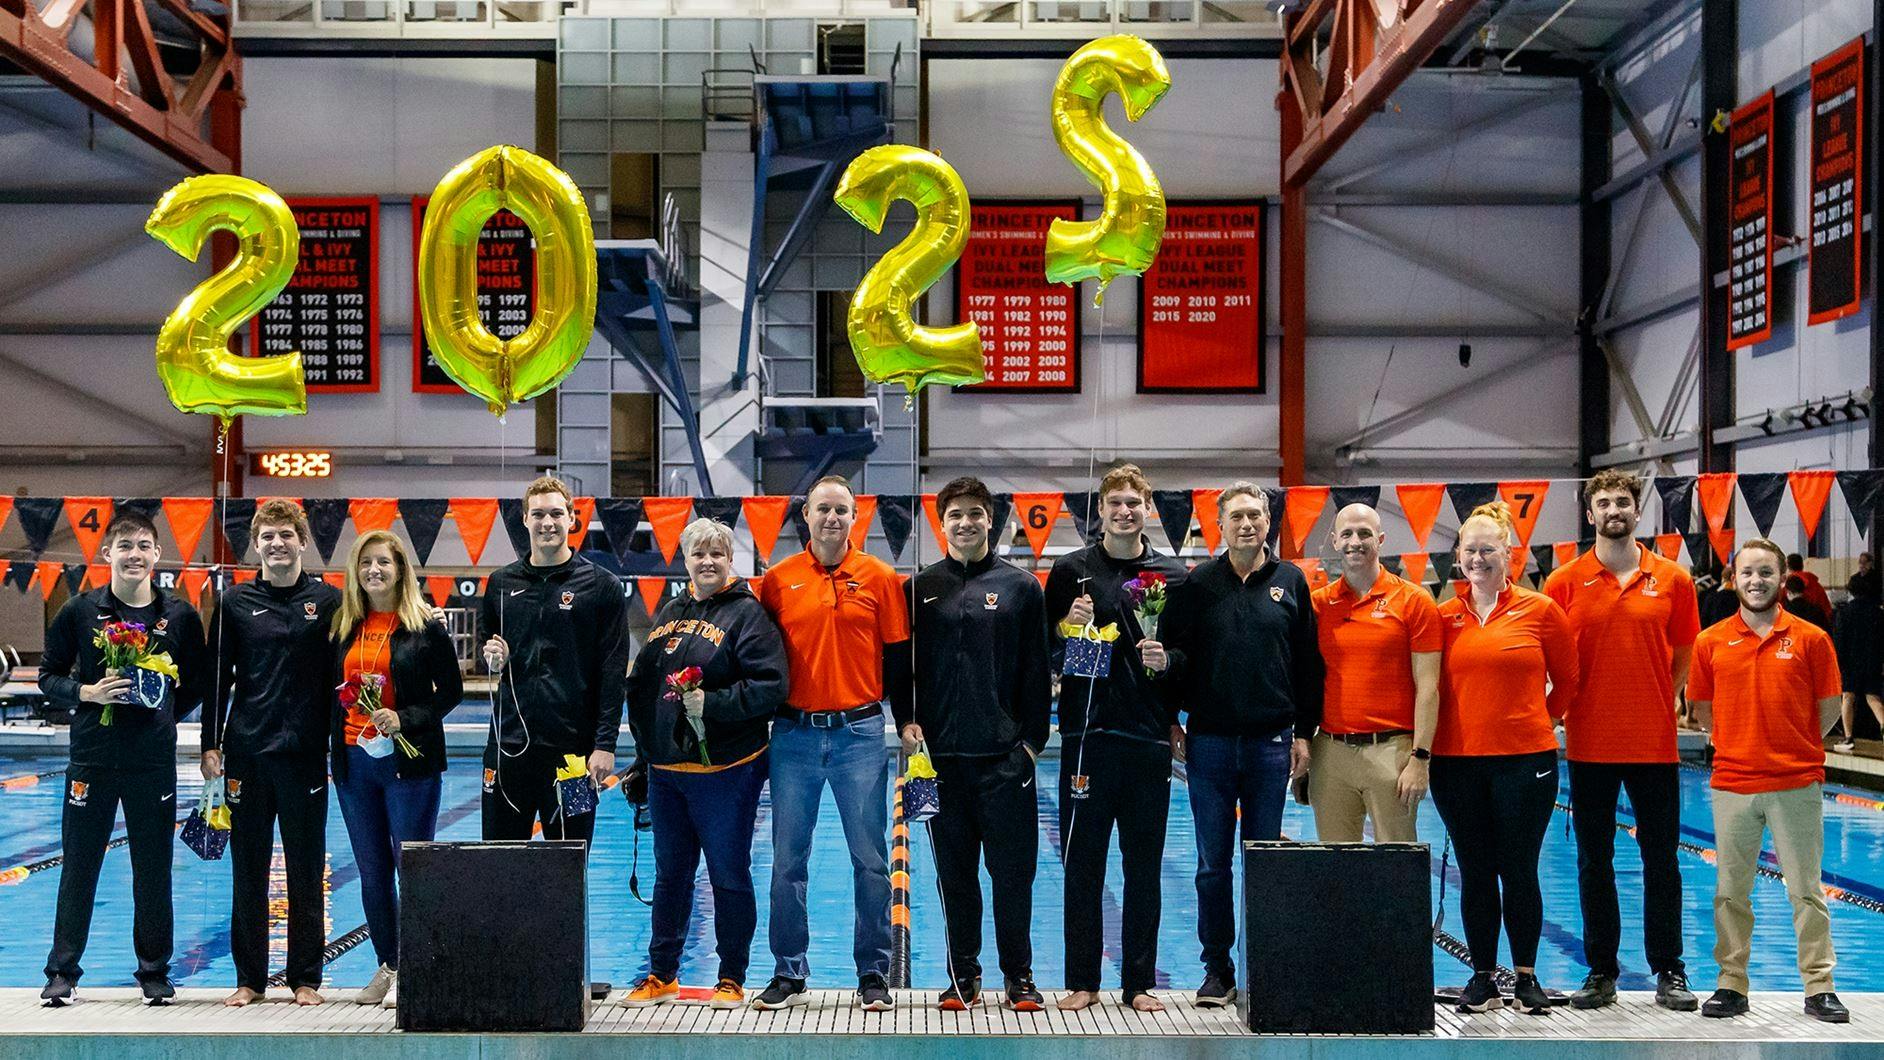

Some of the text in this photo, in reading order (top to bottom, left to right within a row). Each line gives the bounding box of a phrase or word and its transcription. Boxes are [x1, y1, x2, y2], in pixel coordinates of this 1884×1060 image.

[295, 212, 366, 227] NCETON
[327, 243, 352, 257] IVY
[491, 244, 516, 256] IVY
[1187, 244, 1245, 257] LEAGUE
[316, 259, 357, 272] MEET
[479, 259, 520, 272] MEET
[974, 261, 1014, 272] DUAL
[1159, 260, 1244, 273] DUAL MEET
[290, 275, 359, 288] AMPIONS
[477, 275, 522, 288] PIONS
[1158, 276, 1247, 289] CHAMPIONS
[273, 294, 364, 305] 63 1972 1973
[478, 295, 527, 305] 95 1997
[968, 295, 1067, 306] 1977 1979 1980
[1152, 295, 1251, 307] 2009 2010 2011
[264, 309, 364, 320] 1974 1975 1976
[498, 310, 527, 321] 2003
[968, 311, 1067, 321] 1981 1982 1990
[1152, 311, 1216, 322] 2015 2020
[264, 324, 364, 335] 1977 1978 1980
[1003, 325, 1031, 336] 1992
[1039, 325, 1067, 336] 1994
[264, 339, 364, 350] 1984 1985 1986
[981, 341, 1067, 352] 95 1999 2000
[302, 355, 364, 365] 1988 1989
[1003, 356, 1030, 367] 2002
[1038, 356, 1066, 367] 2003
[336, 369, 364, 380] 1992
[1003, 371, 1030, 382] 2007
[1038, 371, 1066, 382] 2008
[1514, 493, 1536, 518] 7
[78, 508, 101, 532] 4
[1028, 505, 1048, 529] 6
